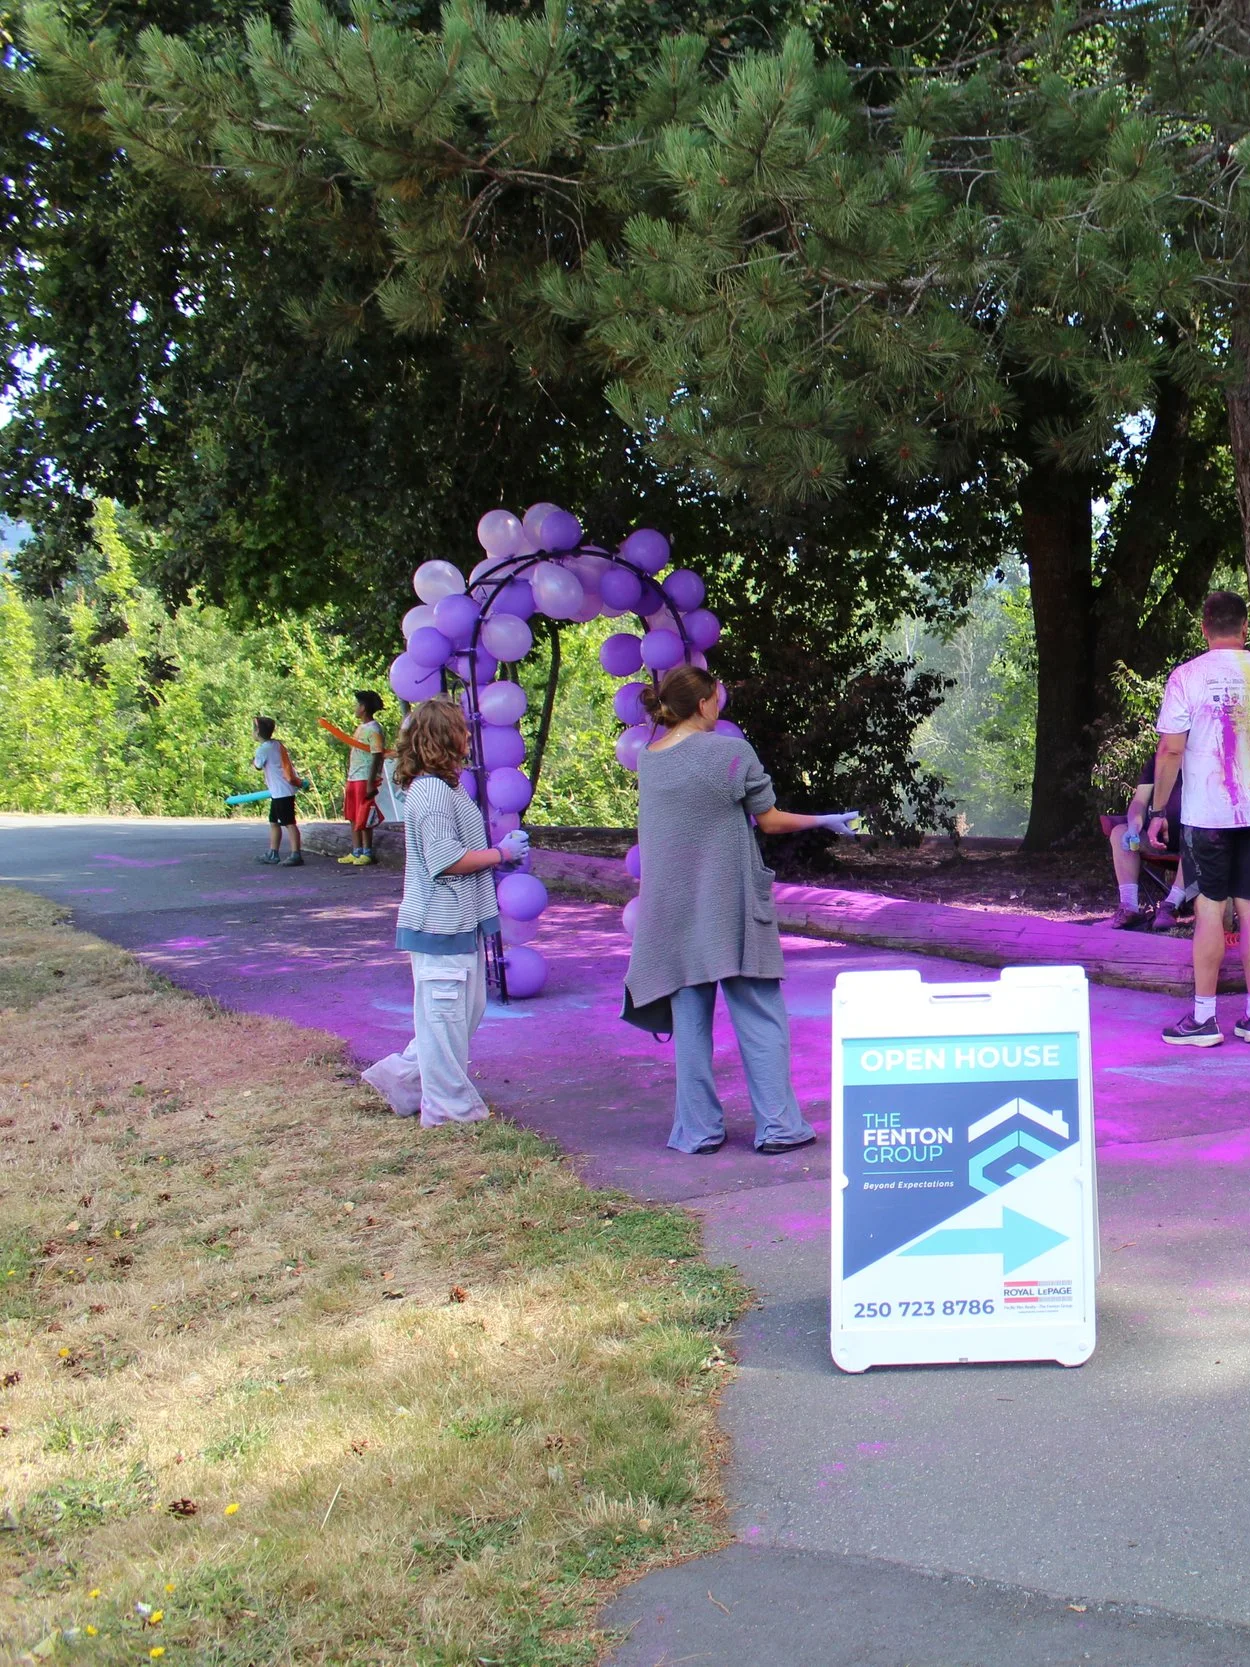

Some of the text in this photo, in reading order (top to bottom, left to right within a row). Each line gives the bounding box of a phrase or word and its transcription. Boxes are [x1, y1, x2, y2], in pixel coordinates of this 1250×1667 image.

[860, 1044, 1060, 1072] OPEN HOUSE
[862, 1112, 901, 1128] THE
[863, 1127, 953, 1146] FENTON
[863, 1145, 943, 1163] GROUP
[863, 1179, 954, 1191] Beyond Expectations
[1003, 1288, 1035, 1297] ROYAL
[853, 1298, 995, 1319] 250 723 8786
